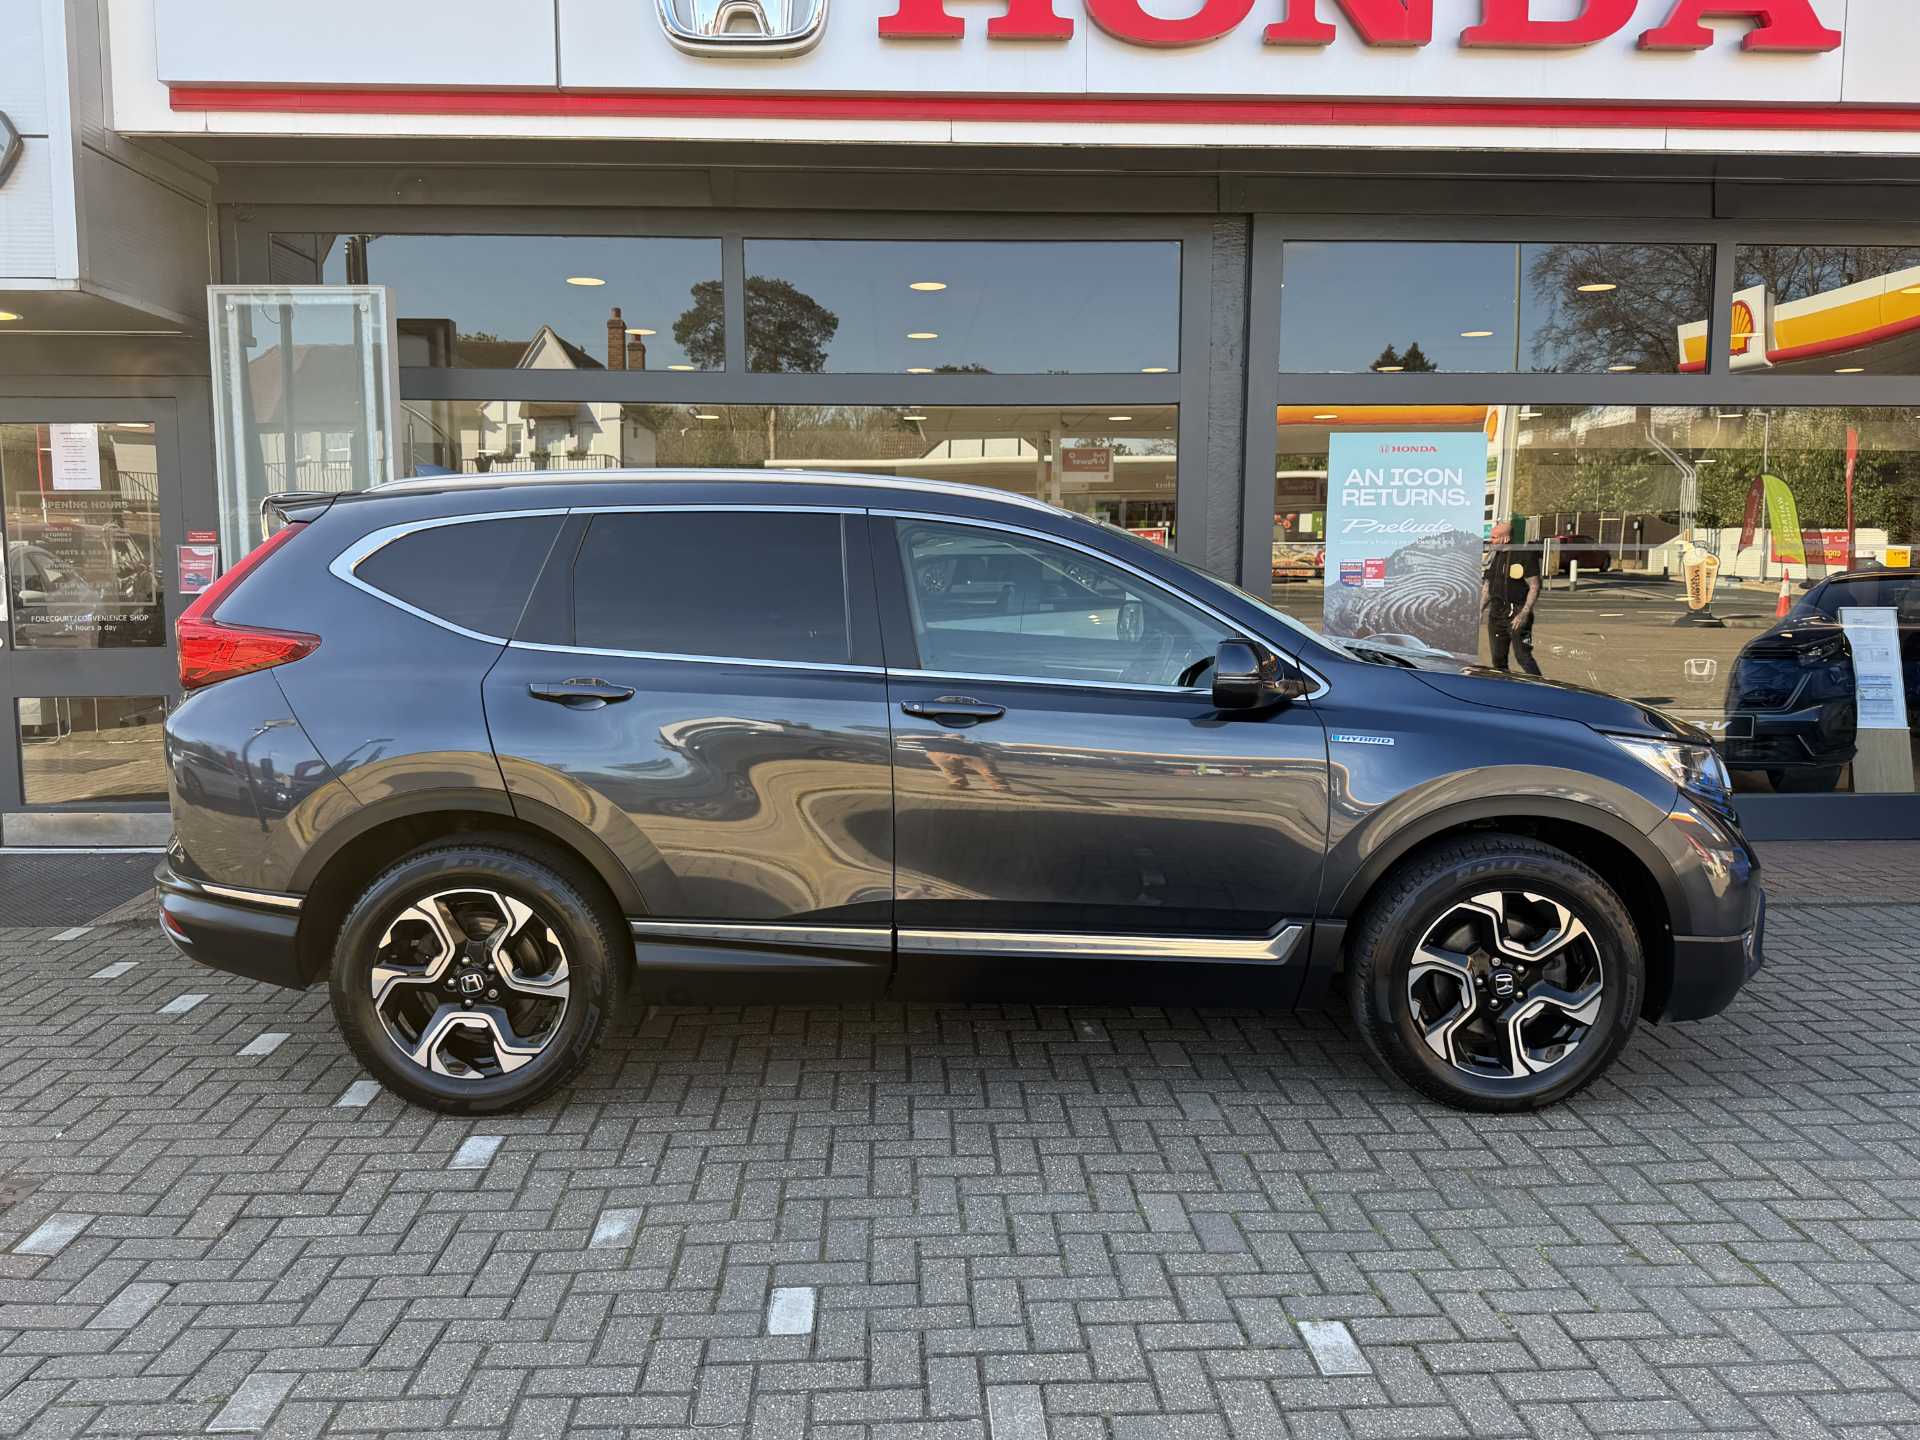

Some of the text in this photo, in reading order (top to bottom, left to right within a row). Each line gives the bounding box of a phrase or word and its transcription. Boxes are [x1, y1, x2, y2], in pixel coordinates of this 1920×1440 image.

[1344, 468, 1463, 486] AN ICON
[1342, 488, 1472, 507] RETURNS.
[91, 501, 129, 509] HOURS
[1342, 518, 1455, 534] Prelude
[129, 614, 149, 622] SHOP
[104, 624, 117, 632] day
[1341, 735, 1391, 744] HYBRID
